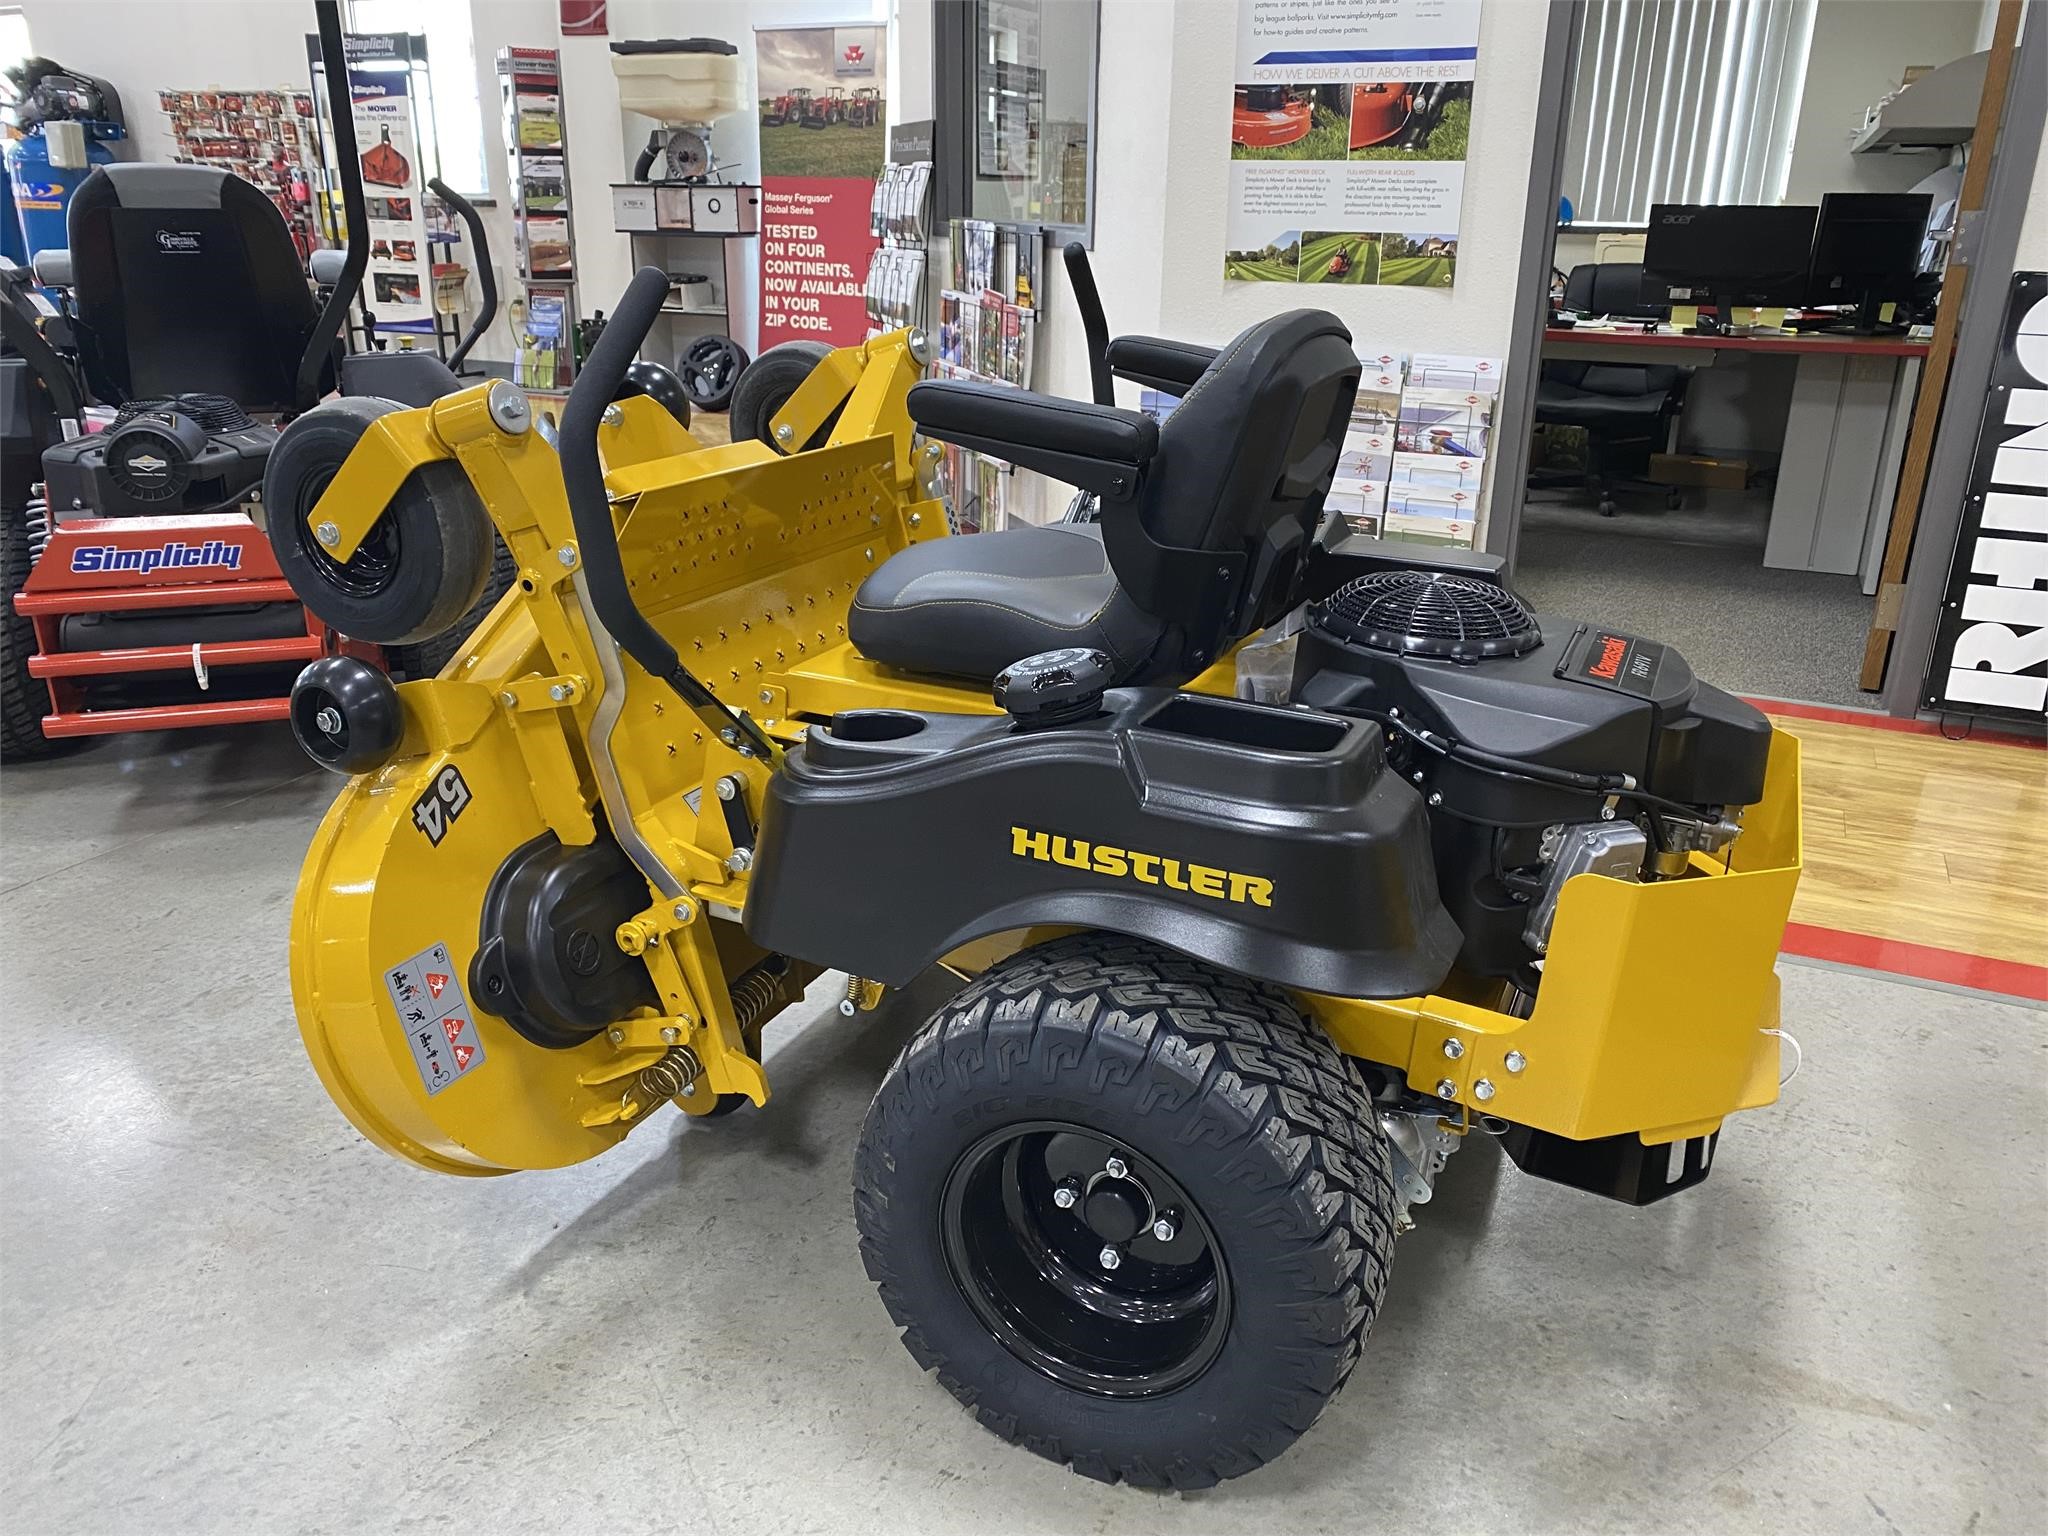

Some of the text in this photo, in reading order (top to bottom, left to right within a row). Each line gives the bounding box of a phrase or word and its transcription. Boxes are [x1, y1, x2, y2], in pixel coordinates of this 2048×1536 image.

[1254, 14, 1265, 23] big
[1254, 28, 1262, 36] for
[1284, 27, 1304, 37] guides
[345, 37, 394, 51] Simplicity
[1254, 68, 1282, 80] HOW
[1286, 68, 1302, 80] WE
[1306, 67, 1340, 80] DELIVER
[1354, 66, 1374, 78] CUT
[1377, 66, 1412, 78] ABOVE
[1416, 66, 1434, 78] THE
[1438, 65, 1460, 77] REST
[368, 104, 397, 112] MOWER
[764, 192, 793, 204] Massey
[764, 204, 814, 215] Global Series
[1662, 214, 1696, 224] acer
[765, 224, 818, 239] TESTED
[765, 242, 825, 258] ON FOUR
[765, 260, 854, 278] CONTINENTS.
[765, 278, 796, 292] NOW
[765, 296, 819, 312] IN YOUR
[765, 314, 832, 331] ZIP CODE.
[71, 541, 242, 575] Simplicity
[1588, 636, 1627, 680] Kawasaki
[416, 768, 469, 841] 54
[1011, 827, 1274, 907] HUSTLER
